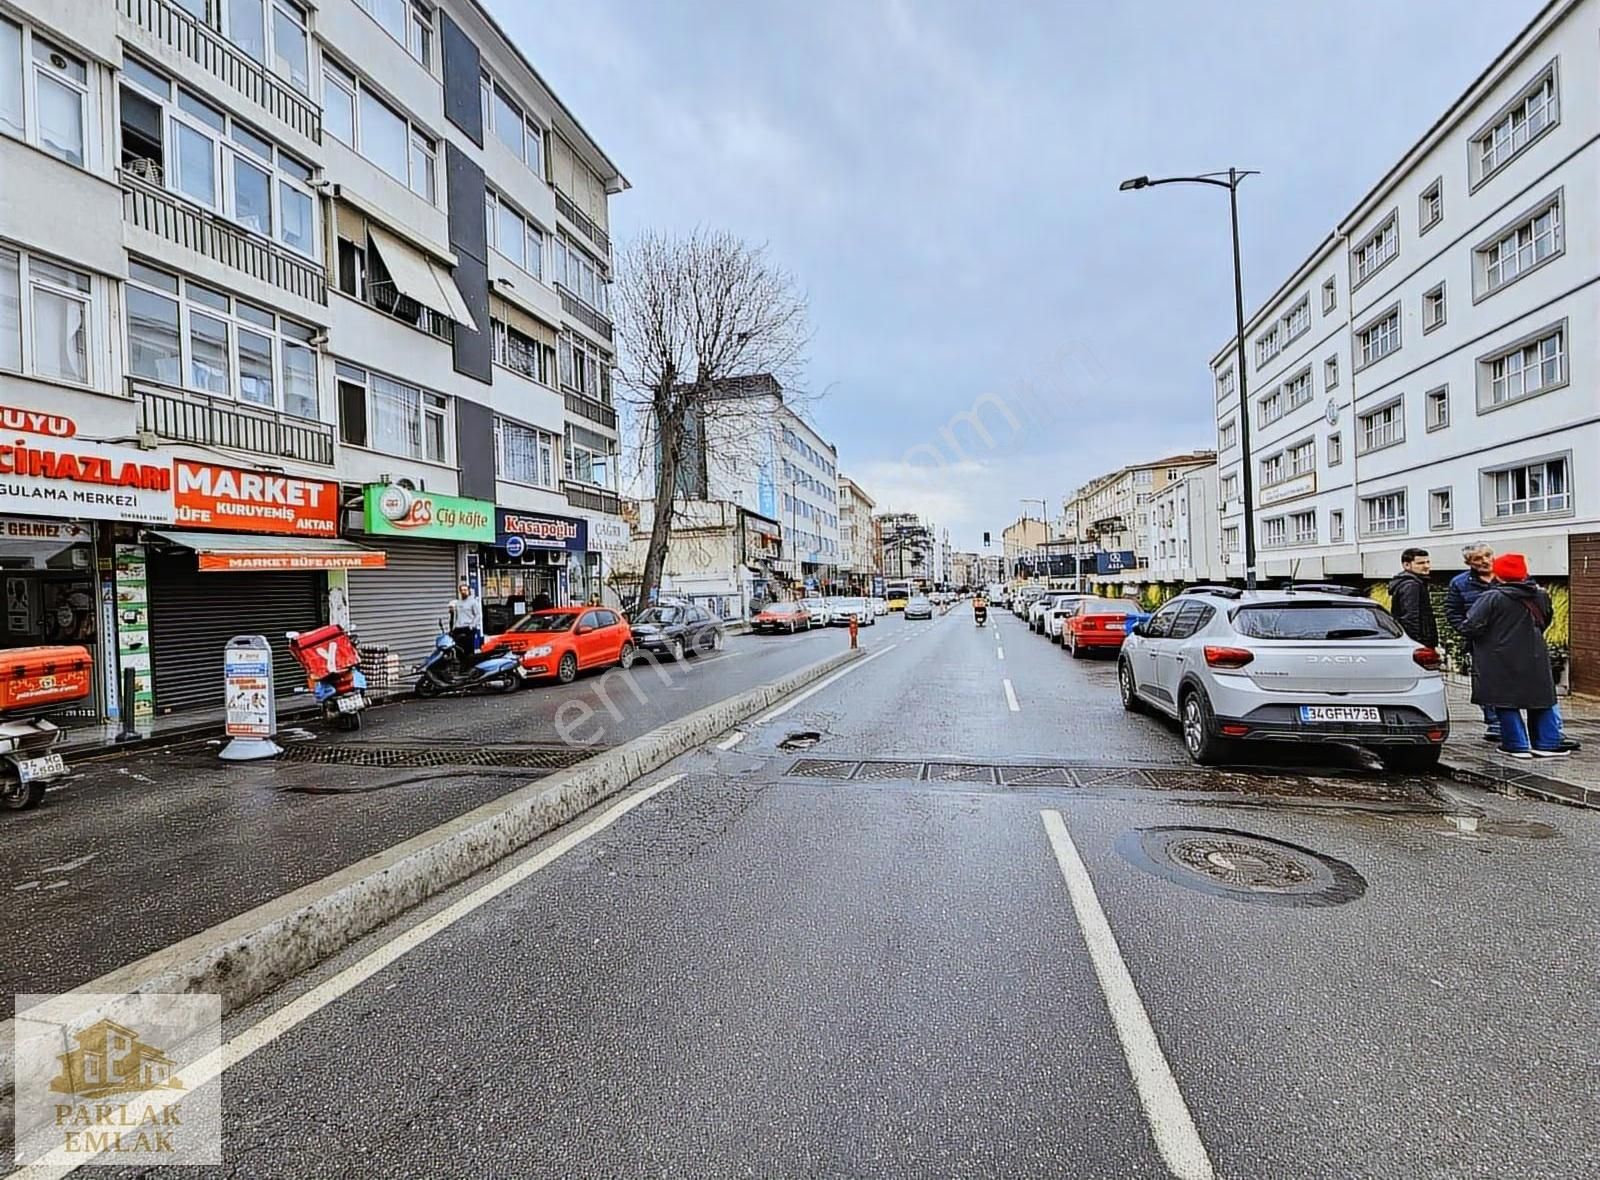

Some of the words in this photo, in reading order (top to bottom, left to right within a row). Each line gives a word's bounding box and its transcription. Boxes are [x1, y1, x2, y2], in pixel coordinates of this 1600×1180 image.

[0, 409, 68, 436] UYU
[178, 463, 324, 508] MARKET
[73, 490, 137, 507] MERKEZİ
[216, 501, 295, 523] KURUYEMİŞ
[8, 522, 60, 538] GELMEZ
[296, 518, 334, 531] AKTAR
[504, 514, 577, 540] Kasapoğlu
[229, 557, 288, 567] MARKET
[290, 556, 322, 567] BÜFE
[1306, 655, 1367, 664] DACIA
